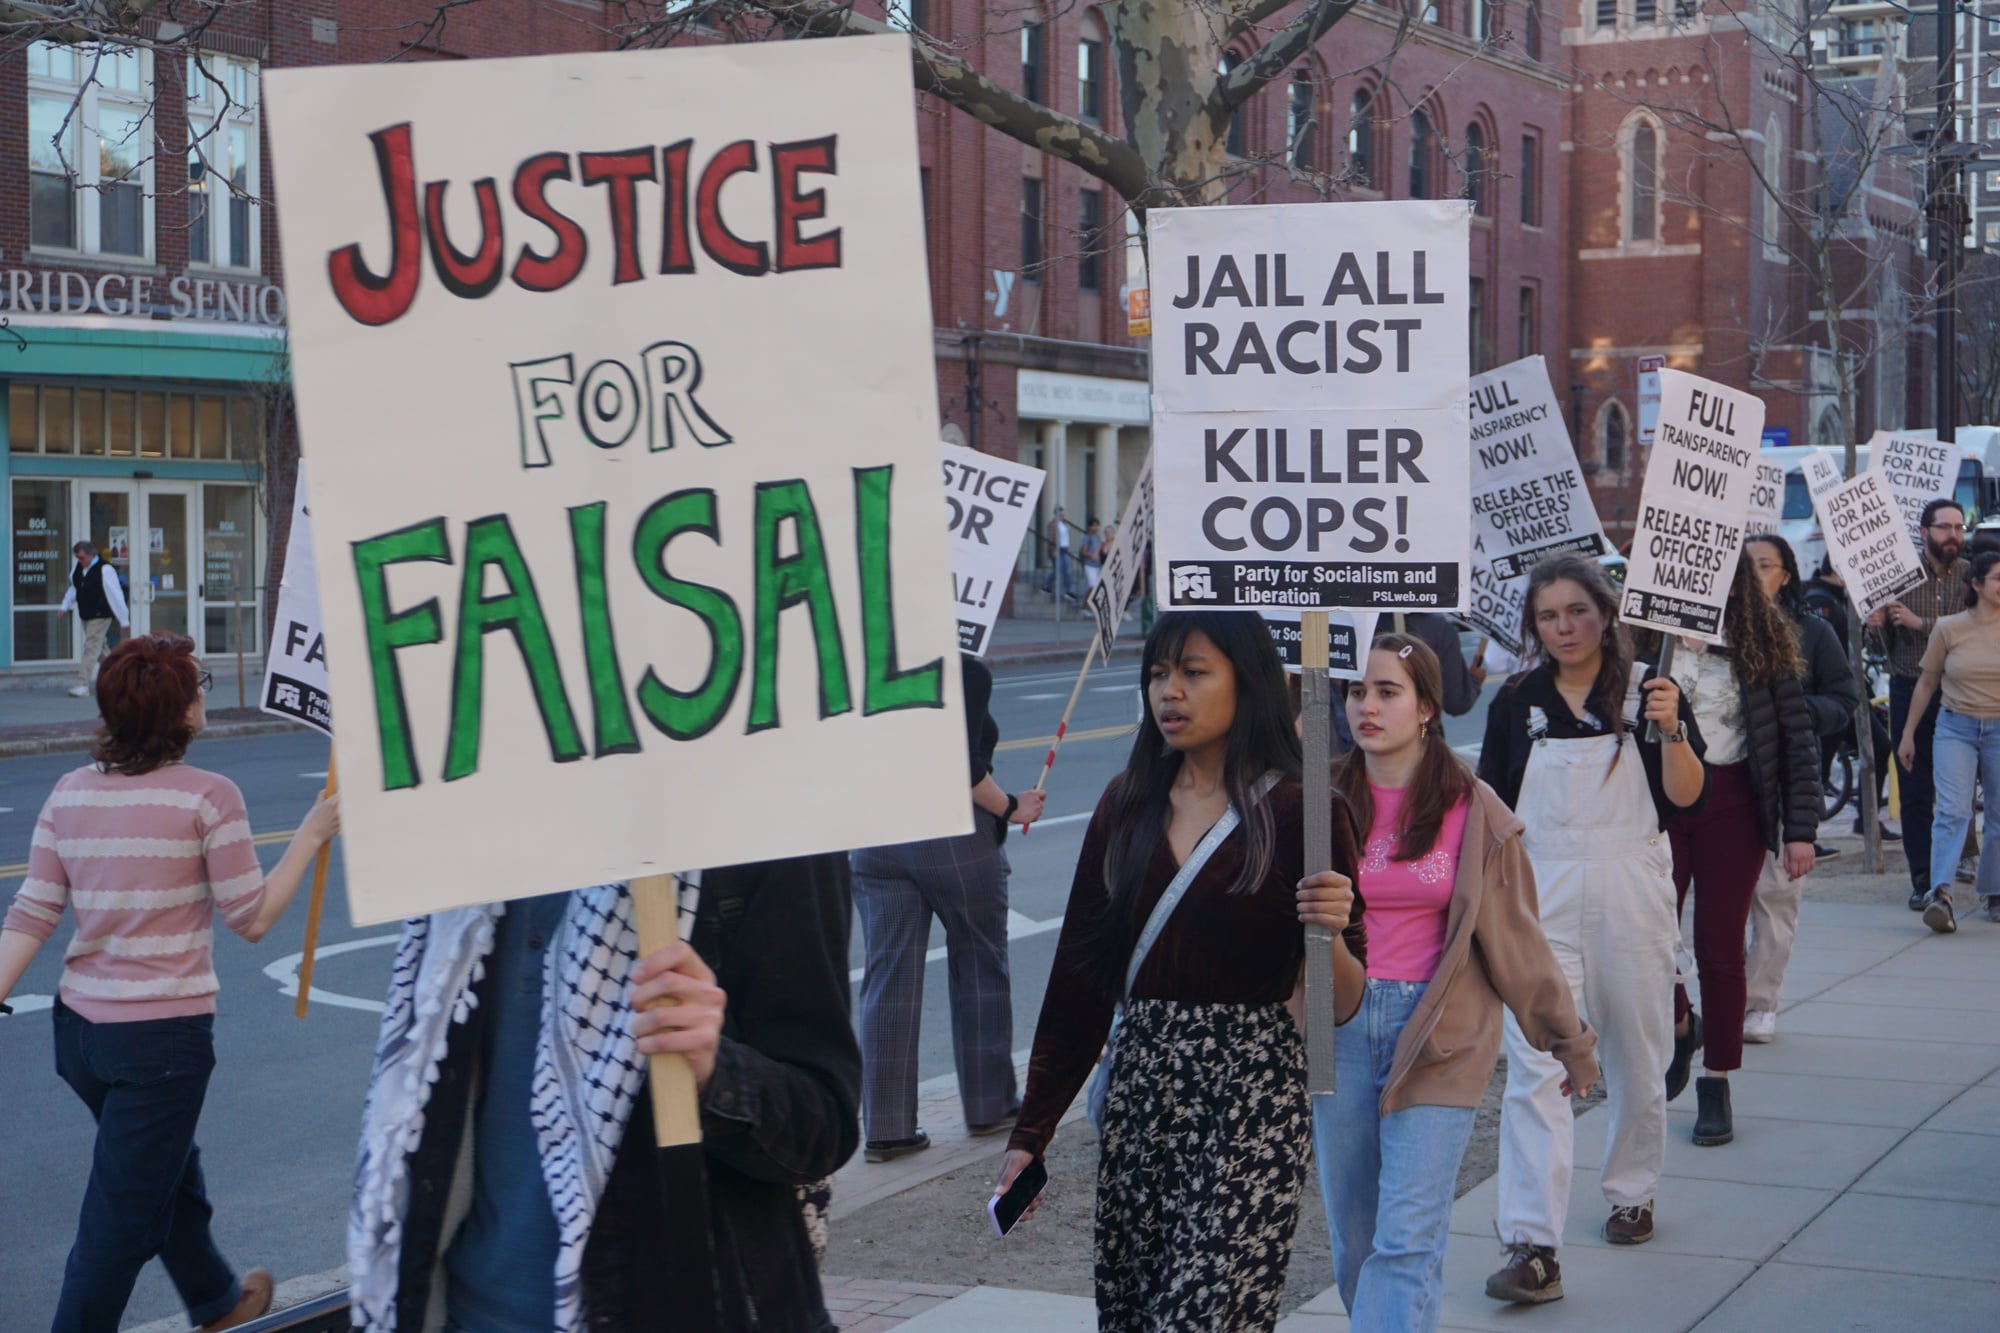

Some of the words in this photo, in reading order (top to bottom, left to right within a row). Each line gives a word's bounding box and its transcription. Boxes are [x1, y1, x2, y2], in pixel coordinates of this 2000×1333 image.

[327, 121, 842, 325] JUSTICE
[0, 269, 153, 315] RIDGE
[168, 276, 287, 325] SENIO
[1172, 253, 1304, 309] JAIL
[1322, 250, 1445, 306] ALL
[1184, 318, 1422, 375] RACIST
[510, 341, 734, 472] FOR
[1688, 389, 1735, 436] FULL
[1204, 428, 1430, 483] KILLER
[1479, 433, 1537, 470] NOW!
[1662, 424, 1751, 468] TRANSPARENCY
[1886, 440, 1947, 461] JUSTICE
[1672, 459, 1728, 500] NOW!
[1882, 455, 1913, 470] FOR
[1916, 462, 1945, 477] ALL
[1472, 480, 1541, 514] RELEASE
[1543, 470, 1578, 495] THE
[1827, 477, 1877, 516] JUSTICE
[29, 518, 47, 529] 806
[1201, 495, 1411, 554] COPS!
[1490, 492, 1571, 531] OFFICERS'
[1643, 506, 1711, 543] RELEASE
[1715, 523, 1739, 550] THE
[1832, 507, 1858, 532] FOR
[1862, 495, 1886, 518] ALL
[1836, 510, 1890, 548] VICTIMS
[1505, 514, 1573, 547] NAMES!
[18, 550, 59, 559] CAMBRIDGE
[1650, 535, 1727, 572] OFFICERS'
[1848, 555, 1859, 569] OF
[1861, 531, 1898, 559] RACIST
[1859, 551, 1898, 578] POLICE
[18, 574, 46, 583] CENTER
[1173, 566, 1217, 599] PSL
[1234, 565, 1280, 585] Party
[1284, 565, 1308, 583] for
[1313, 565, 1398, 583] Socialism
[1404, 566, 1437, 584] and
[1234, 587, 1320, 604] Liberation
[1373, 591, 1437, 604] PSLweb.org
[1653, 562, 1714, 597] NAMES!
[1862, 562, 1906, 593] TERROR!
[1648, 609, 1681, 626] Liberation
[1650, 596, 1667, 612] Party
[1668, 599, 1680, 612] for
[1680, 602, 1709, 618] Socialism
[351, 464, 945, 791] FAISAL
[1334, 632, 1349, 645] and
[1329, 650, 1350, 662] web.org
[274, 686, 302, 711] PSL
